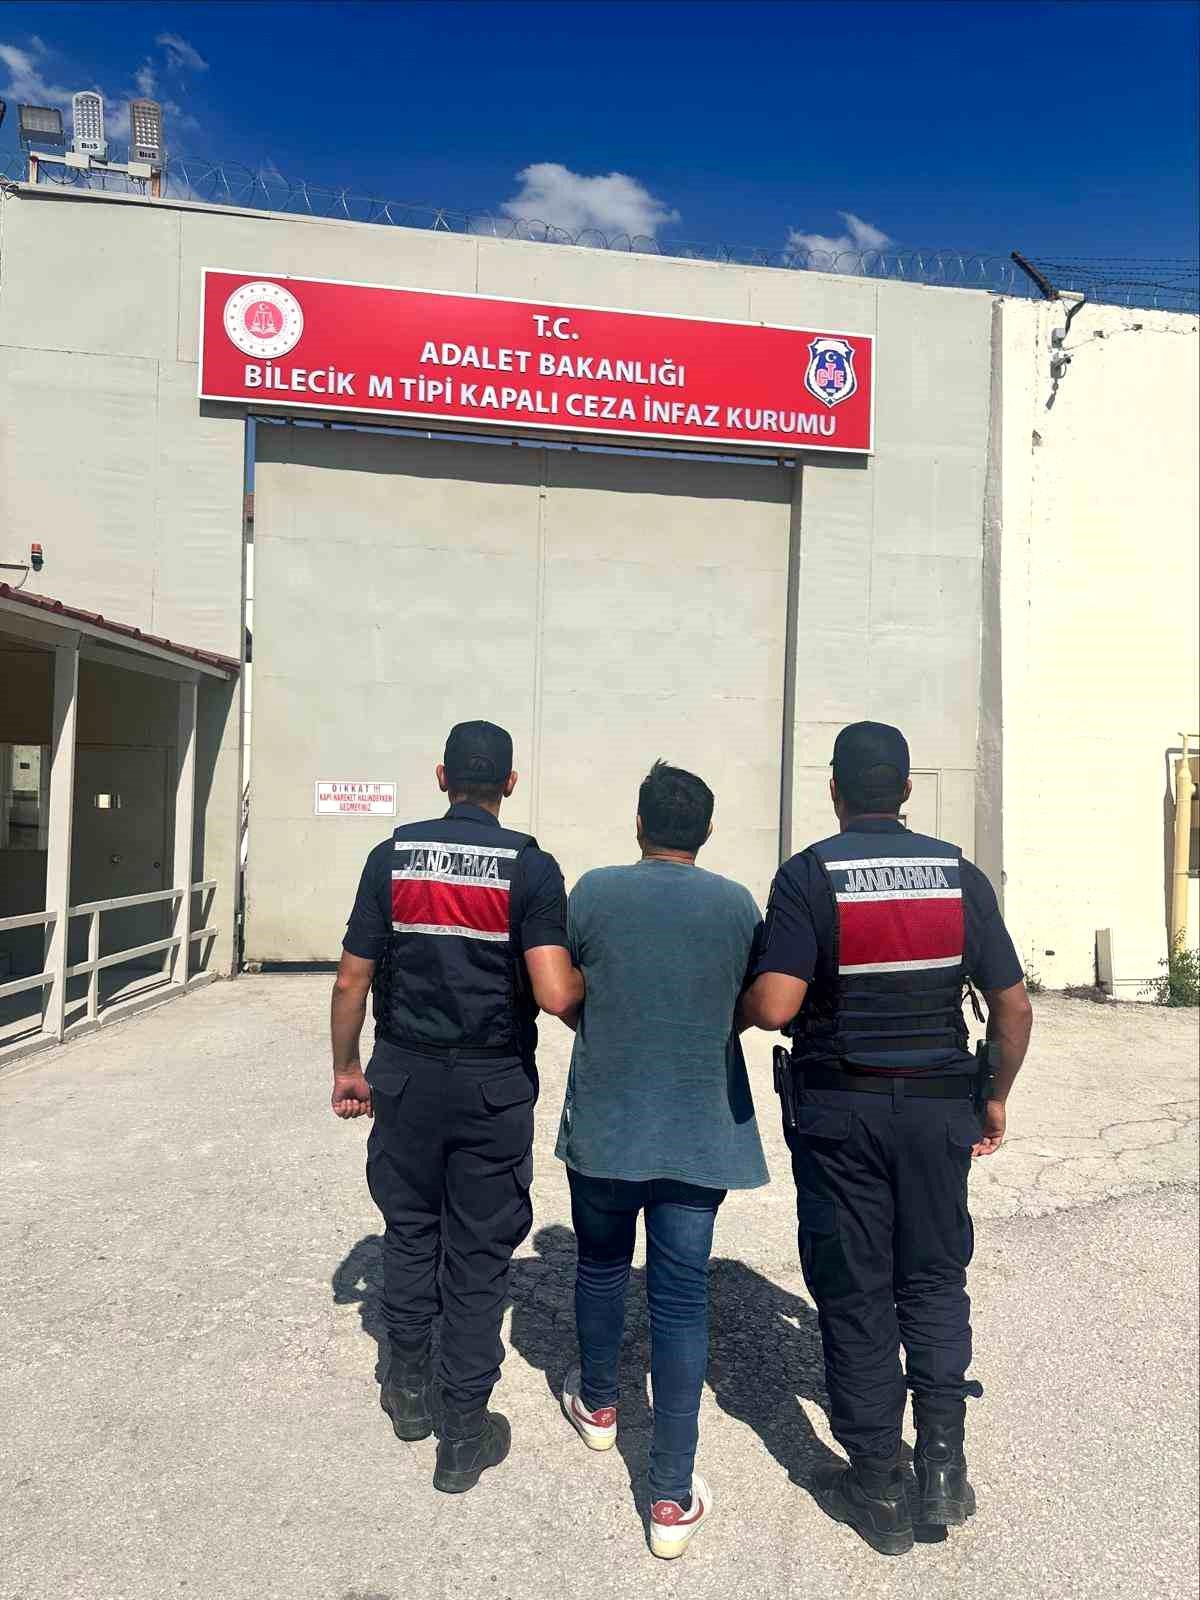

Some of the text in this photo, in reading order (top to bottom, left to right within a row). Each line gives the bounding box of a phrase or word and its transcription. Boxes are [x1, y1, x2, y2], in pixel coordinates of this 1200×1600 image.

[532, 313, 580, 341] T.C.
[420, 341, 685, 387] ADALET BAKANLIĞI
[244, 360, 836, 437] BİLECİK M TİPİ KAPALI CEZA İNFAZ KURUMU
[403, 849, 499, 880] JANDARMA
[845, 866, 949, 892] JANDARMA
